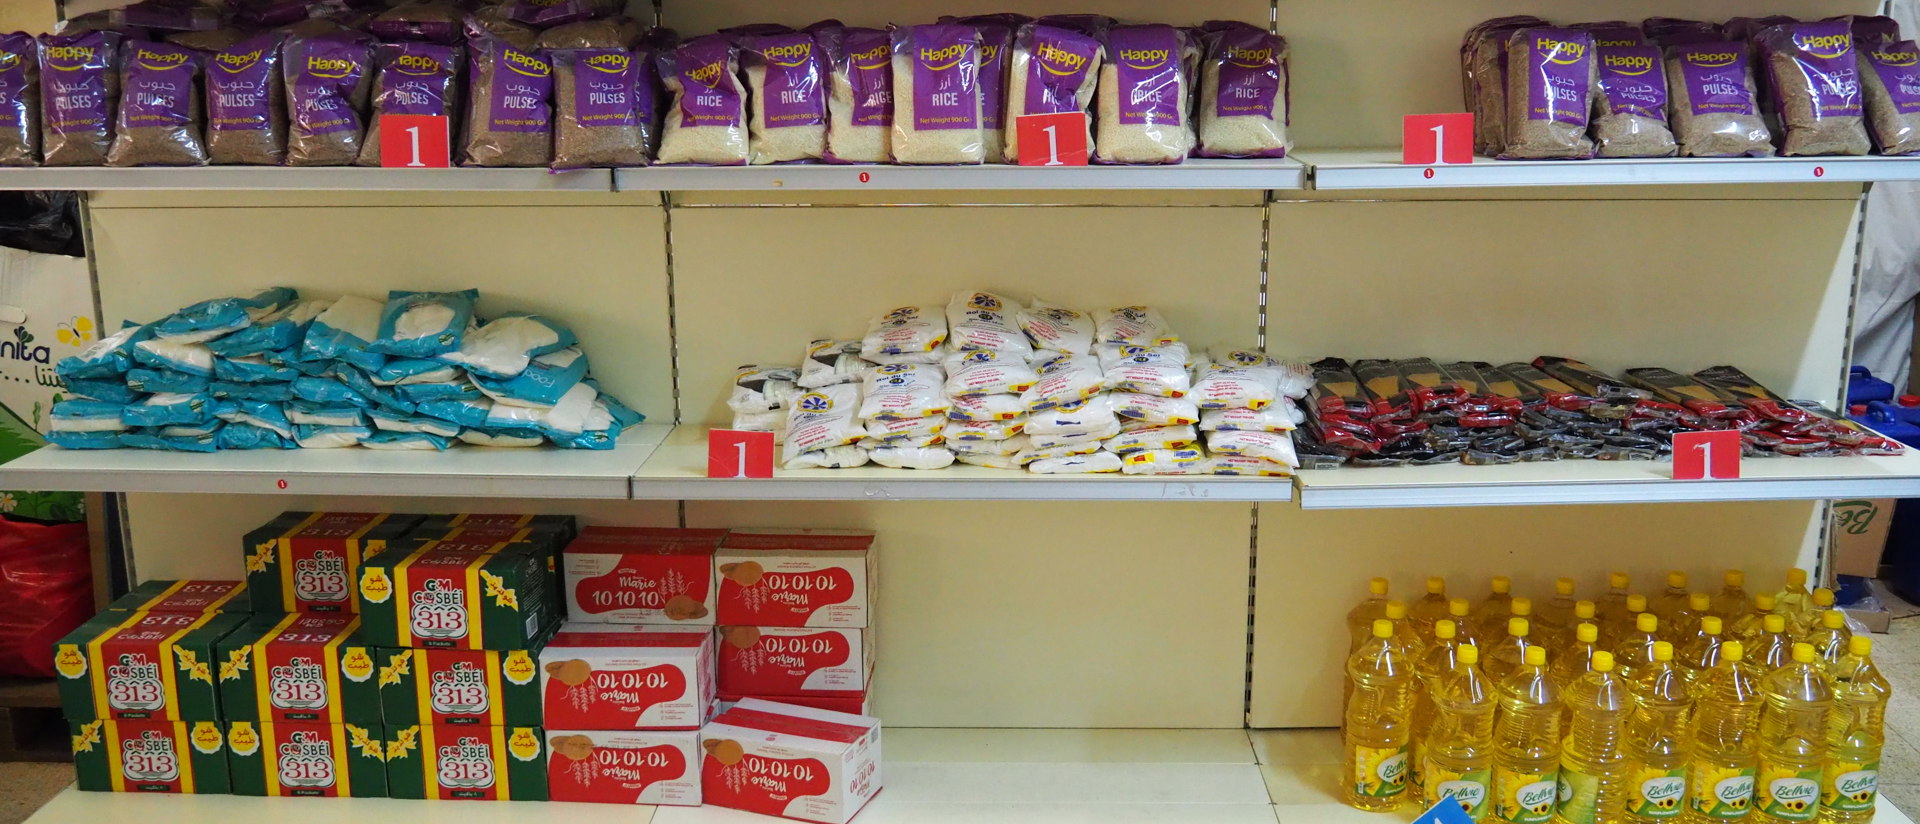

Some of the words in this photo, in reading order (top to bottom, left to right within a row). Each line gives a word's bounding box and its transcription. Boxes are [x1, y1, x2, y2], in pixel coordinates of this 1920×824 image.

[1537, 37, 1585, 57] Happy
[1802, 34, 1850, 49] Happy
[45, 46, 96, 62] Happy
[137, 48, 188, 64] Happy
[215, 49, 263, 67] Happy
[764, 43, 811, 60] Happy
[920, 43, 968, 62] Happy
[1037, 42, 1086, 69] Happy
[1120, 48, 1169, 62] Happy
[1228, 45, 1272, 61] Happy
[1687, 52, 1738, 62] Happy
[1873, 50, 1918, 61] Happy
[307, 56, 356, 73] Happy
[503, 49, 552, 75] Happy
[584, 54, 631, 68] Happy
[1605, 54, 1653, 69] Happy
[685, 60, 723, 82] Happy
[1137, 89, 1162, 103] RICE
[1235, 87, 1260, 99] RICE
[1543, 85, 1577, 102] PULSES
[1703, 84, 1739, 95] PULSES
[1822, 80, 1857, 97] PULSES
[55, 94, 92, 110] PULSES
[136, 92, 175, 109] PULSES
[218, 94, 255, 108] PULSES
[305, 98, 338, 112] PULSES
[395, 91, 429, 106] PULSES
[503, 95, 538, 110] PULSES
[589, 92, 626, 105] PULSES
[696, 95, 723, 107] RICE
[781, 90, 807, 105] RICE
[868, 90, 892, 107] RICE
[932, 92, 959, 106] RICE
[504, 119, 525, 127] Weight
[593, 113, 614, 121] Weight
[694, 114, 714, 122] Weight
[780, 114, 800, 122] Weight
[930, 116, 951, 125] Weight
[405, 126, 426, 167] 1
[1043, 125, 1064, 166] 1
[1429, 124, 1450, 166] 1
[733, 442, 749, 478] 1
[1693, 441, 1717, 480] 1
[183, 584, 233, 593] 313
[301, 575, 344, 593] 313
[366, 584, 388, 593] طيب
[619, 575, 657, 591] Marie
[769, 574, 790, 590] 10
[793, 575, 814, 590] 10
[816, 575, 837, 590] 10
[592, 590, 613, 606] 10
[615, 590, 636, 606] 10
[638, 590, 659, 606] 10
[771, 590, 809, 605] Marie
[142, 616, 195, 625] 313
[417, 611, 462, 630] 313
[278, 633, 332, 642] 313
[766, 638, 787, 653] 10
[789, 639, 811, 654] 10
[813, 639, 833, 654] 10
[513, 657, 526, 666] شو
[768, 653, 805, 668] Marie
[509, 665, 532, 673] طيب
[598, 673, 620, 688] 10
[622, 673, 645, 688] 10
[646, 673, 669, 688] 10
[114, 684, 159, 702] 313
[276, 682, 321, 701] 313
[437, 687, 483, 705] 313
[601, 689, 639, 704] Marie
[128, 755, 173, 773] 313
[600, 749, 622, 766] 10
[623, 751, 645, 766] 10
[647, 751, 669, 767] 10
[285, 761, 330, 779] 313
[443, 761, 489, 780] 313
[602, 766, 641, 780] Marie
[749, 757, 769, 774] 10
[771, 761, 791, 778] 10
[793, 765, 814, 781] 10
[751, 776, 787, 793] Marie
[1775, 784, 1814, 797] Bellvie
